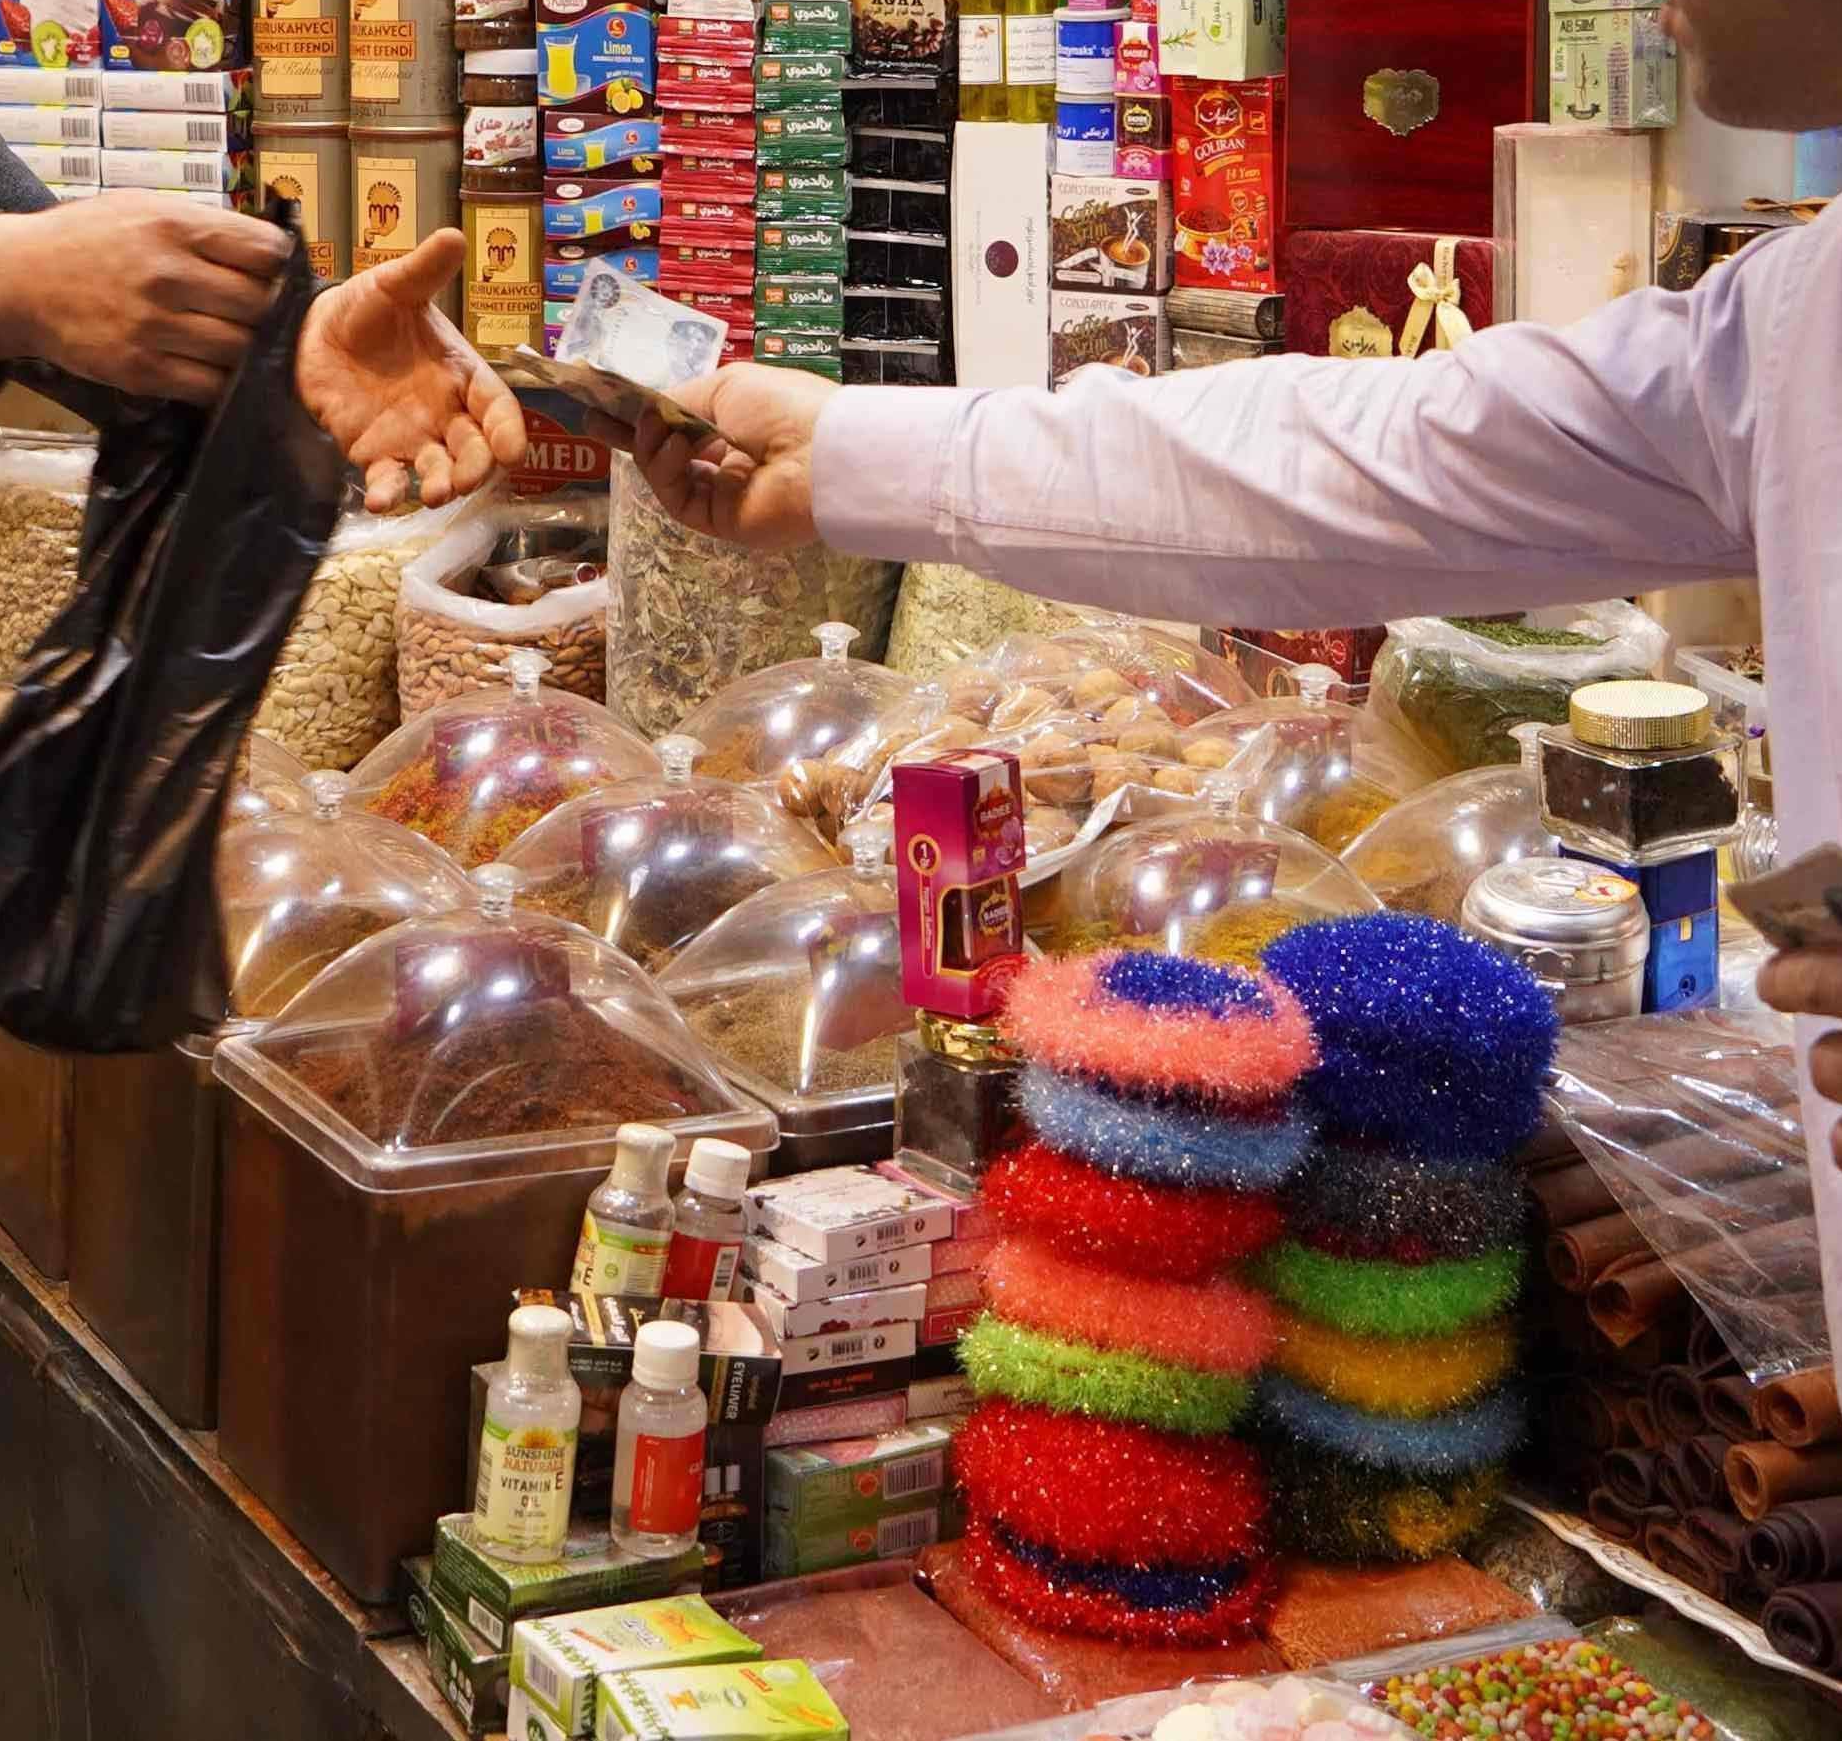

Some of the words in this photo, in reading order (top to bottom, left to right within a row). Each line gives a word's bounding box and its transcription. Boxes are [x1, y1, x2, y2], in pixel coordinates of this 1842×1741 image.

[294, 39, 335, 54] EFENDİ
[602, 40, 632, 56] Limon
[1193, 136, 1246, 160] GOLIRAN
[501, 1475, 552, 1492] VITAMIN
[555, 1471, 564, 1491] E
